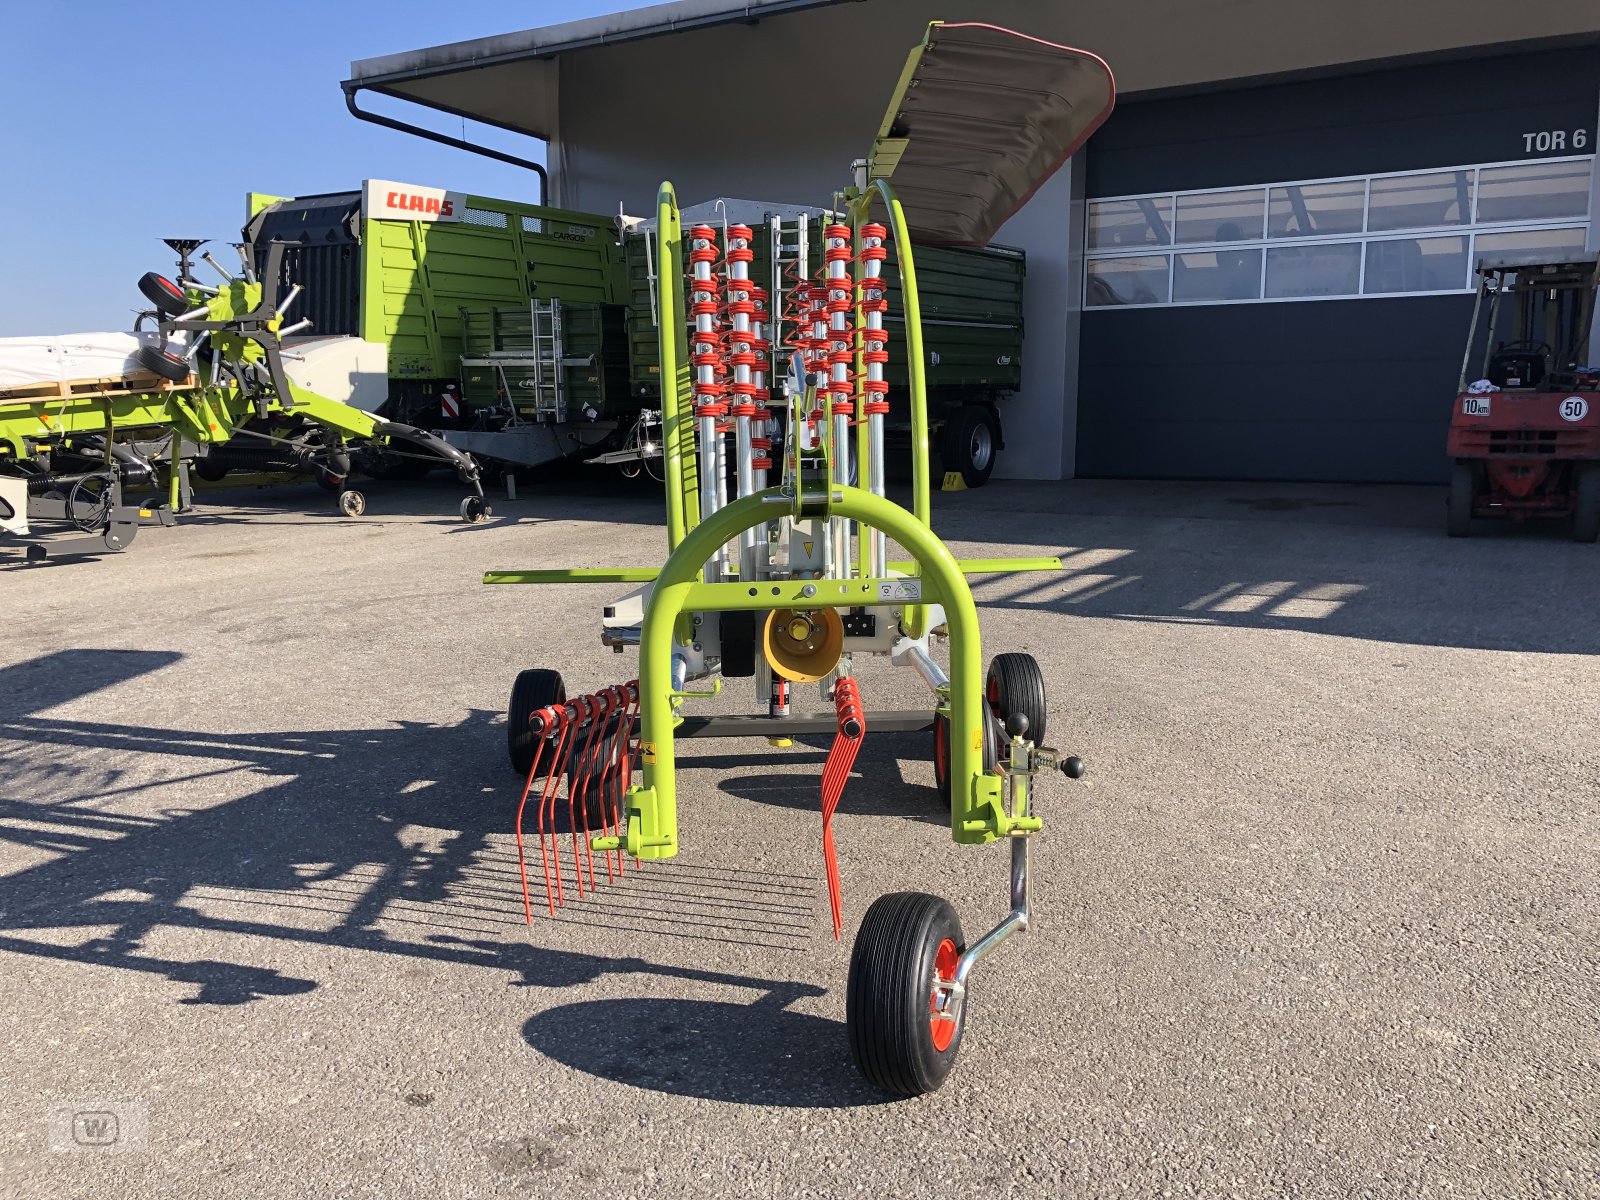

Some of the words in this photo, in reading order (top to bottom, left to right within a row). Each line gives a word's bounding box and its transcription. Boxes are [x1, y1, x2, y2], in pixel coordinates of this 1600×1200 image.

[1523, 130, 1566, 153] TOR
[1572, 128, 1587, 149] 6
[386, 191, 454, 217] CLAAS
[553, 231, 586, 243] CARGOS
[1465, 399, 1478, 414] 10
[1565, 401, 1583, 417] 50
